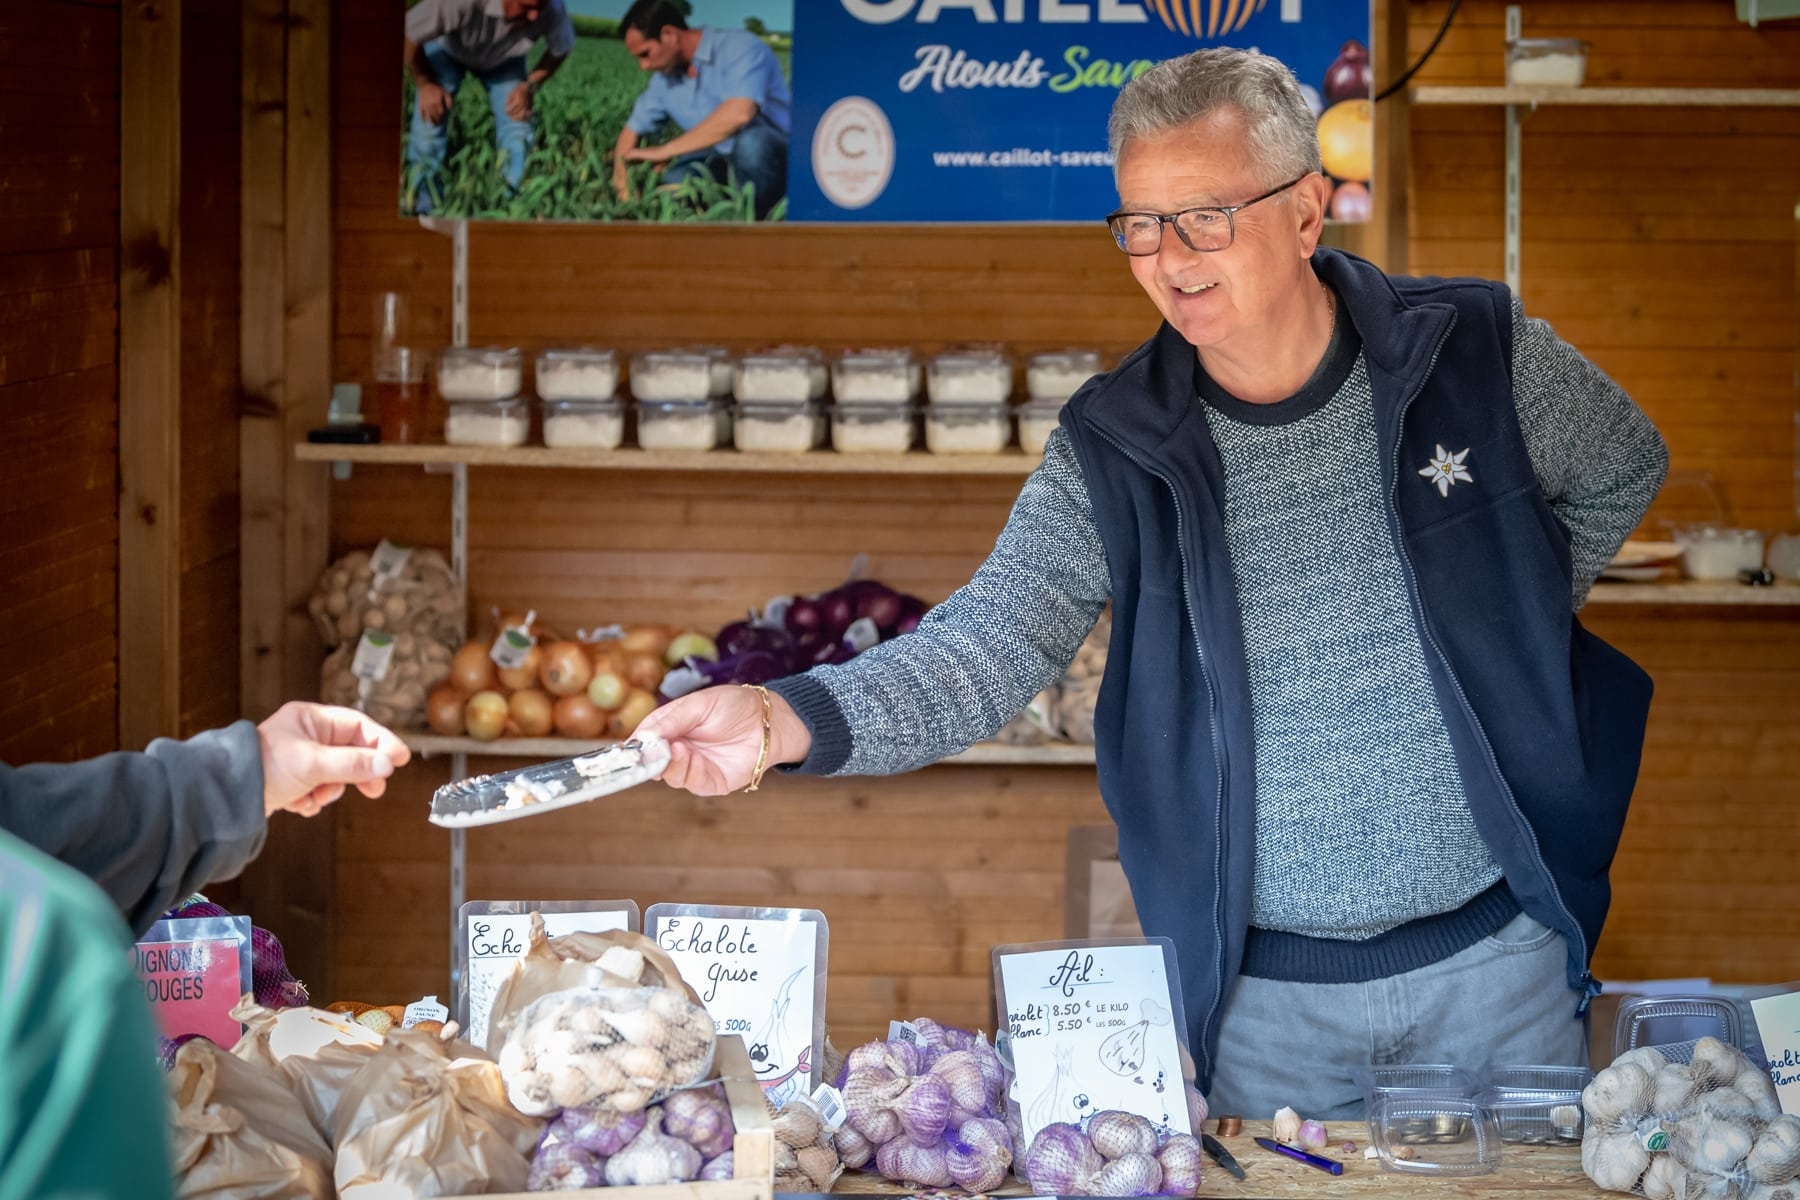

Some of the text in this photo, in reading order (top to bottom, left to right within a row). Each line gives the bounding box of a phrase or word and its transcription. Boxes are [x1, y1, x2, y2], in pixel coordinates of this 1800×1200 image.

[898, 44, 1049, 93] Atouts
[659, 919, 758, 954] Echalote
[144, 976, 204, 1002] OUGES
[703, 961, 758, 1002] grise
[1052, 1003, 1081, 1017] 8.50
[1096, 1003, 1106, 1013] LE
[1110, 1002, 1129, 1012] KILO
[725, 1018, 752, 1033] 500G
[1057, 1019, 1083, 1032] 5.50
